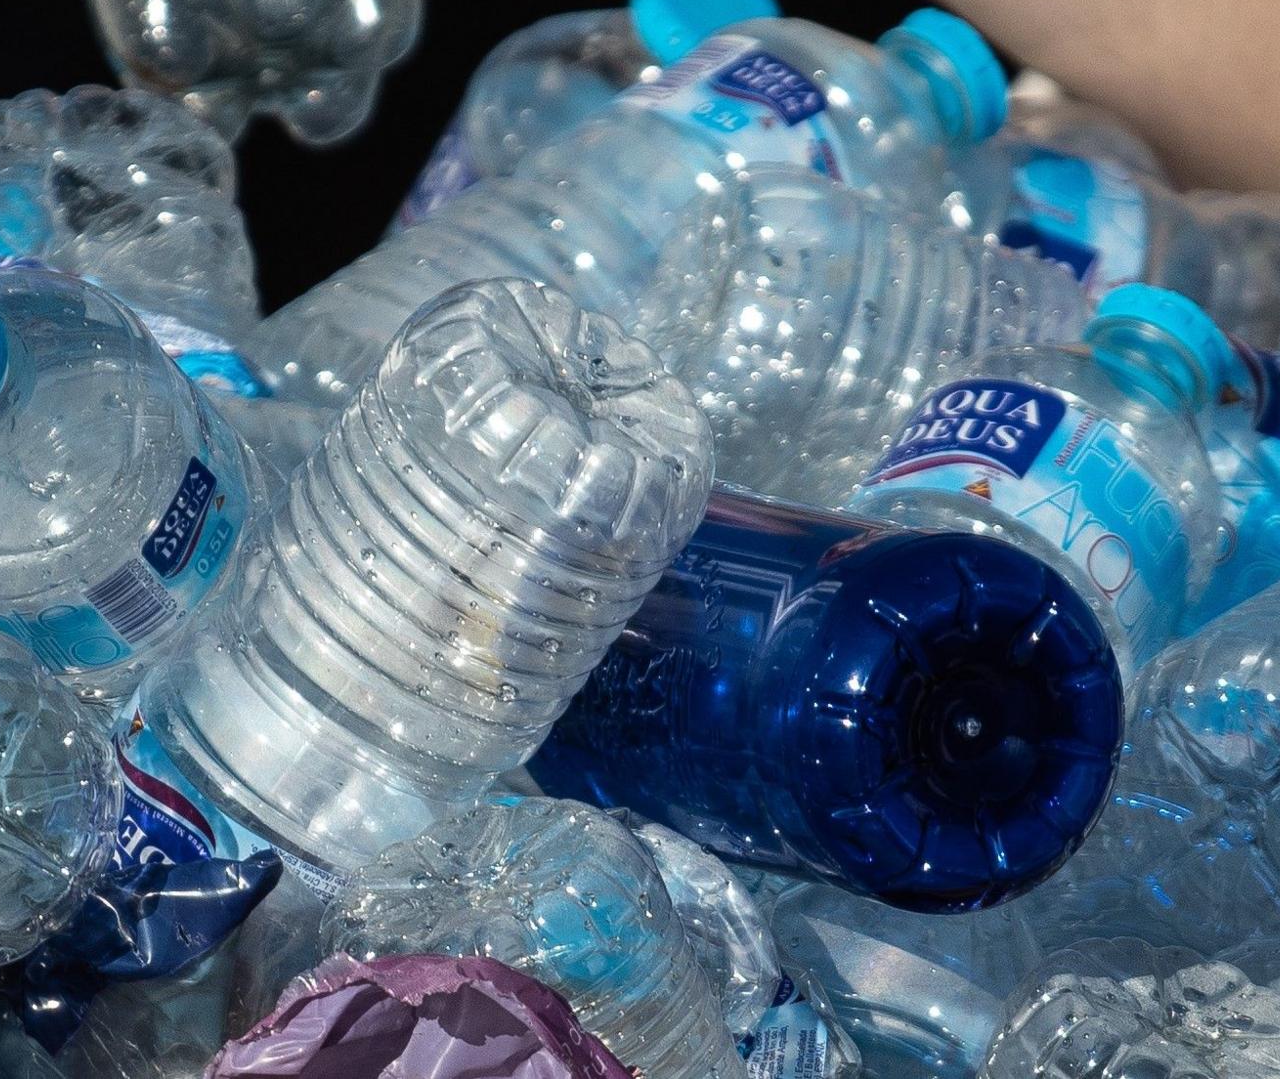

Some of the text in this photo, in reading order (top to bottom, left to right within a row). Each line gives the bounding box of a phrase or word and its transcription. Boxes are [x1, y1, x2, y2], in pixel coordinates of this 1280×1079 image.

[894, 417, 1026, 451] DEUS
[154, 471, 200, 555] AQUA
[161, 480, 208, 559] DEUS
